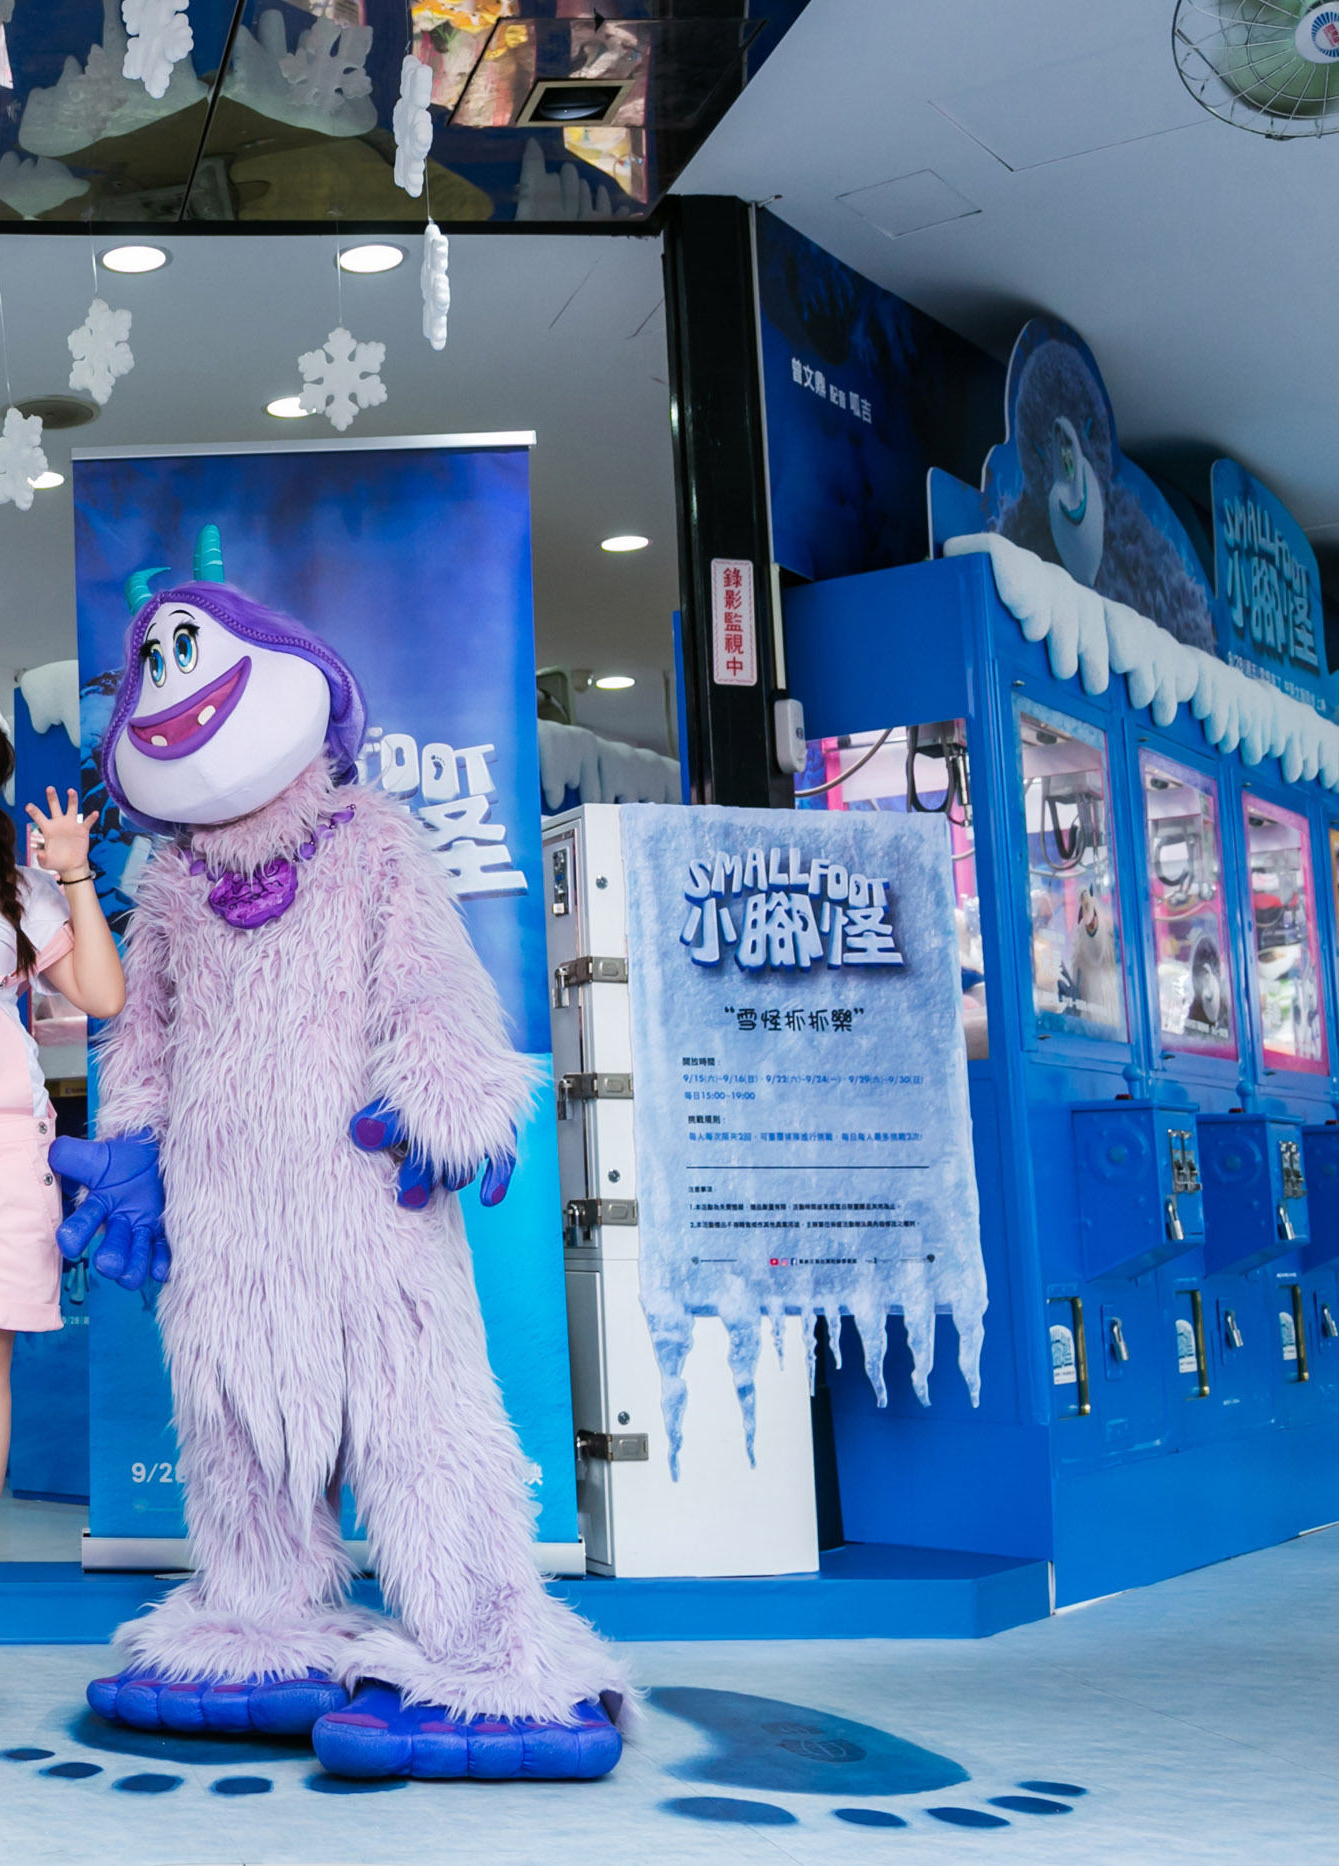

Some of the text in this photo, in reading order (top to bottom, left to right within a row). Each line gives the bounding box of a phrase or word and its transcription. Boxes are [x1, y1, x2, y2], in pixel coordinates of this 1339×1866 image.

[1222, 495, 1309, 600] SMALLFOOT
[723, 567, 745, 677] 錄影監視中
[683, 847, 891, 912] SMALLFOOT
[679, 891, 905, 973] 小腳怪
